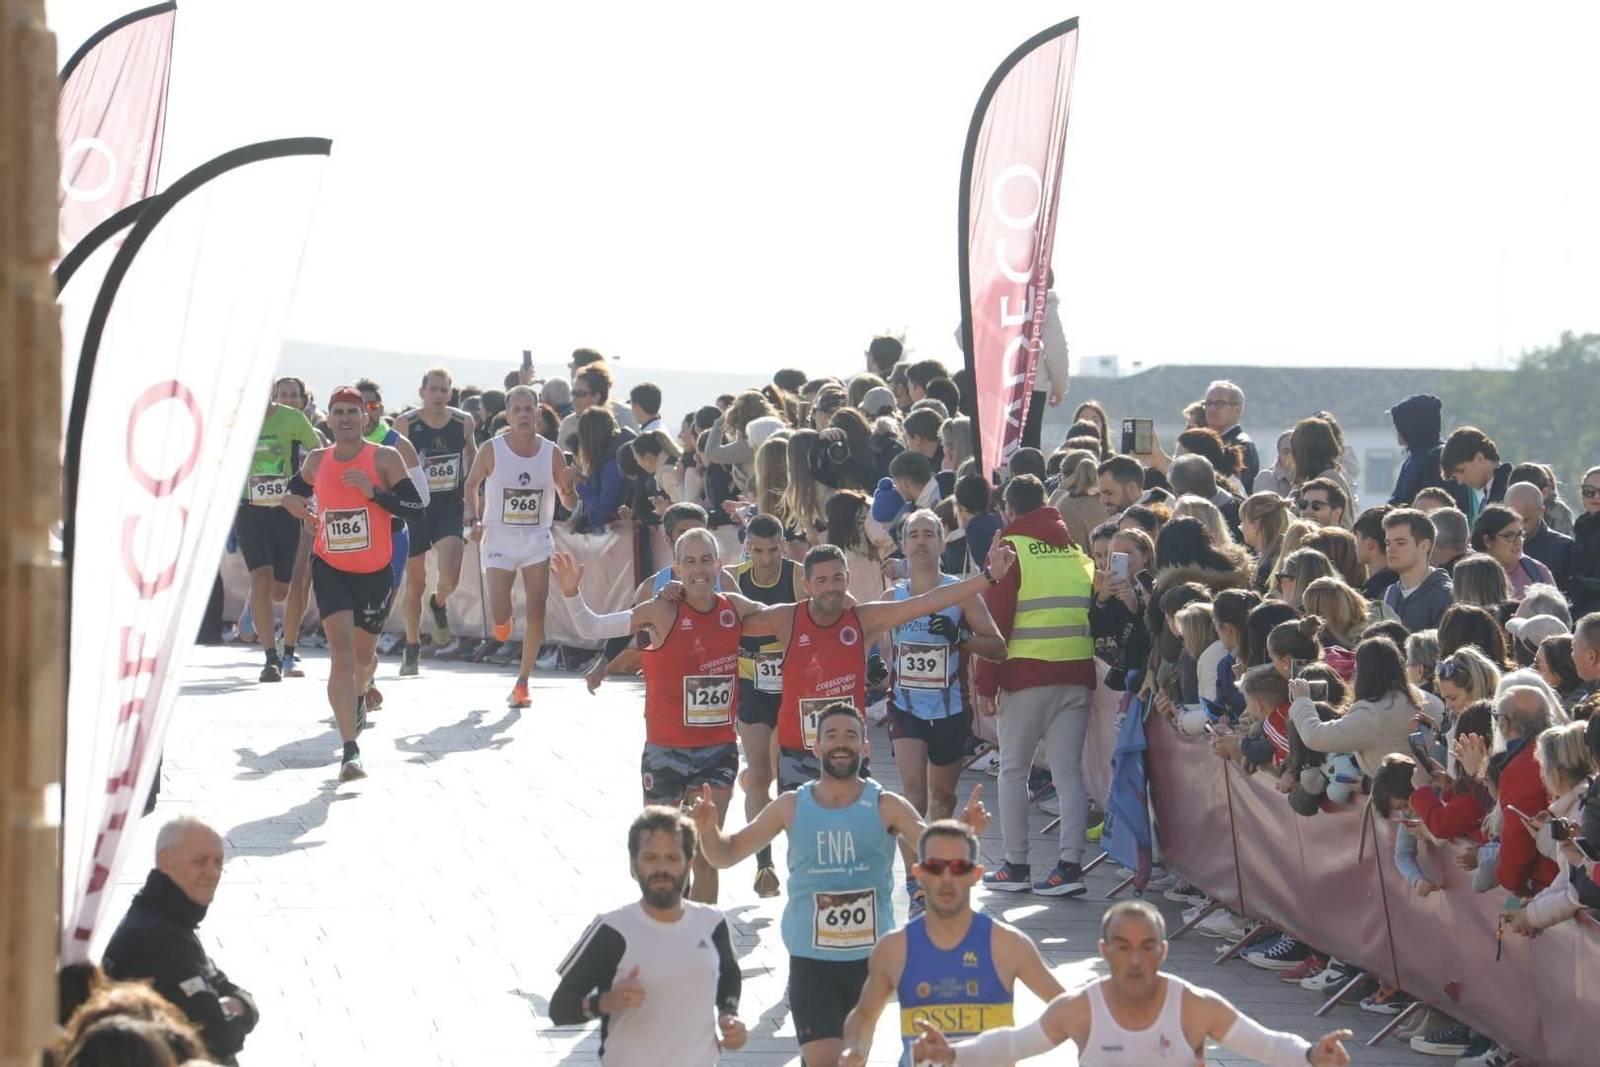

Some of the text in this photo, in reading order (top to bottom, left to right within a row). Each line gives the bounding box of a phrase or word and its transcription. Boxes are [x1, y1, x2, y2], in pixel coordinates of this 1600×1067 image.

[430, 465, 454, 477] 868
[257, 484, 283, 496] 958
[510, 498, 537, 511] 968
[331, 521, 361, 535] 1186
[906, 657, 937, 673] 339
[691, 690, 730, 706] 1260
[816, 829, 856, 866] ENA
[825, 907, 866, 926] 690
[911, 1006, 991, 1033] OSSET
